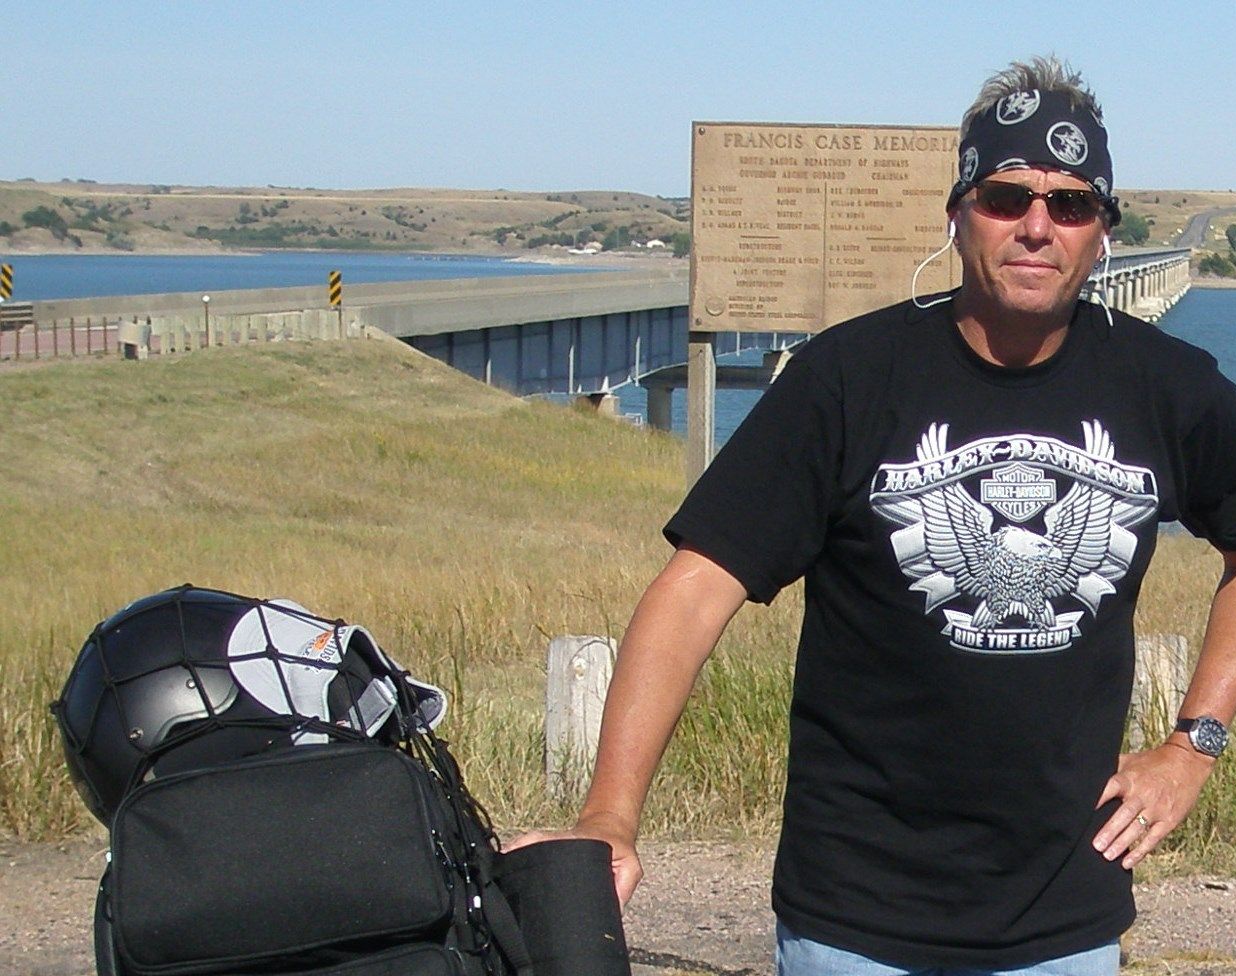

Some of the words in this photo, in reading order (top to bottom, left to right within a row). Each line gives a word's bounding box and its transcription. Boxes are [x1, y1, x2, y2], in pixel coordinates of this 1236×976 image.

[723, 132, 803, 149] FRANCIS
[815, 134, 862, 150] CASE
[873, 136, 958, 152] MEMORIA
[883, 439, 1146, 494] HARLEY-DAVIDSON
[1002, 471, 1036, 483] MOTOR
[1002, 501, 1036, 517] CYCLES
[954, 628, 985, 647] RIDE
[988, 633, 1017, 648] THE
[1020, 629, 1070, 648] LEGEND
